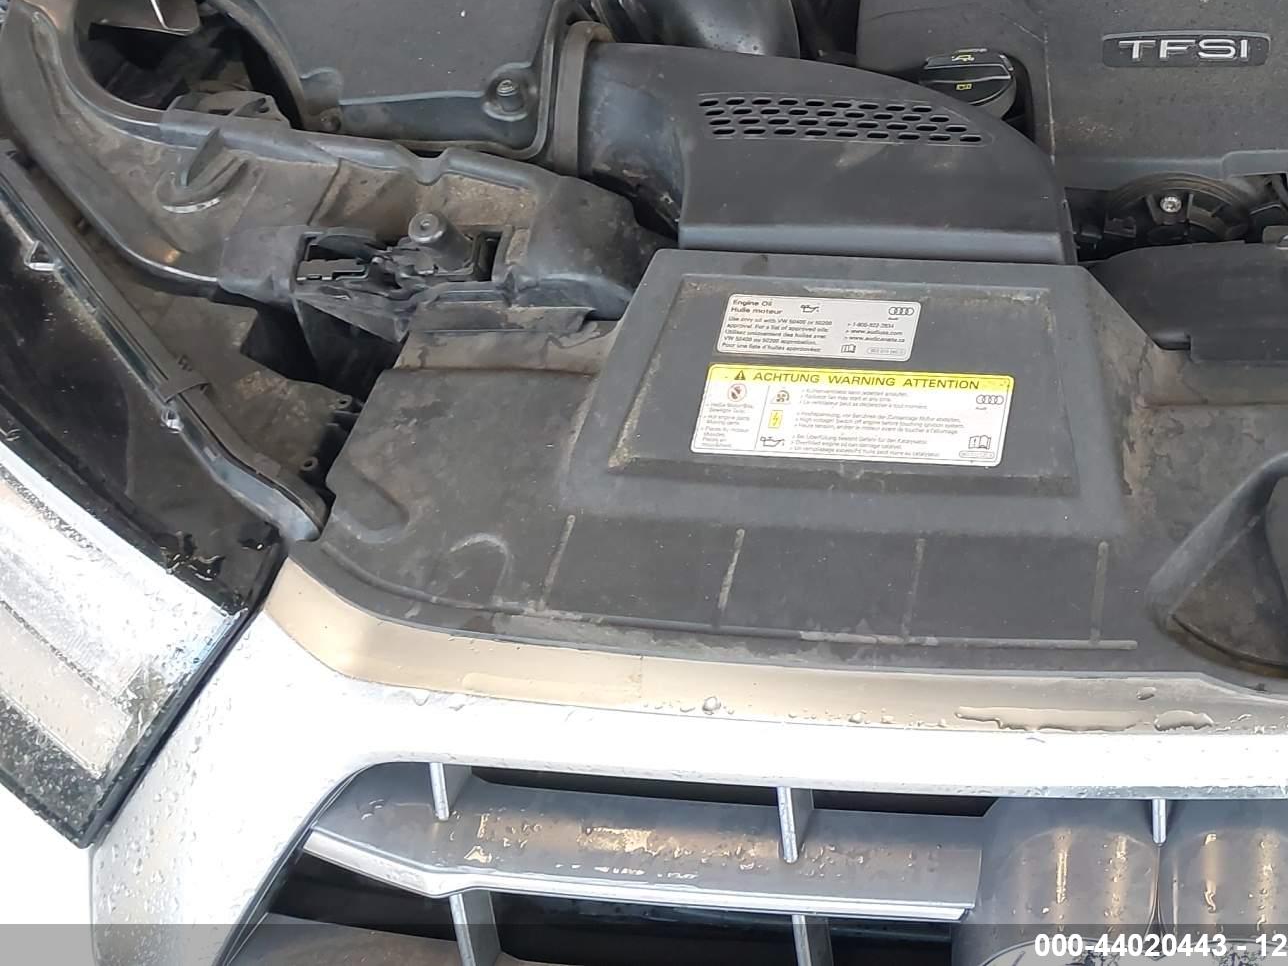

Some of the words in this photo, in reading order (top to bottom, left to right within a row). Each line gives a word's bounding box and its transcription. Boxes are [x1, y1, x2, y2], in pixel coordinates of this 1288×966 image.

[1118, 38, 1249, 60] TFSI
[733, 299, 759, 307] Engine
[753, 372, 820, 384] ACHTUNG
[828, 375, 896, 386] WARNING
[903, 378, 980, 389] ATTENTION
